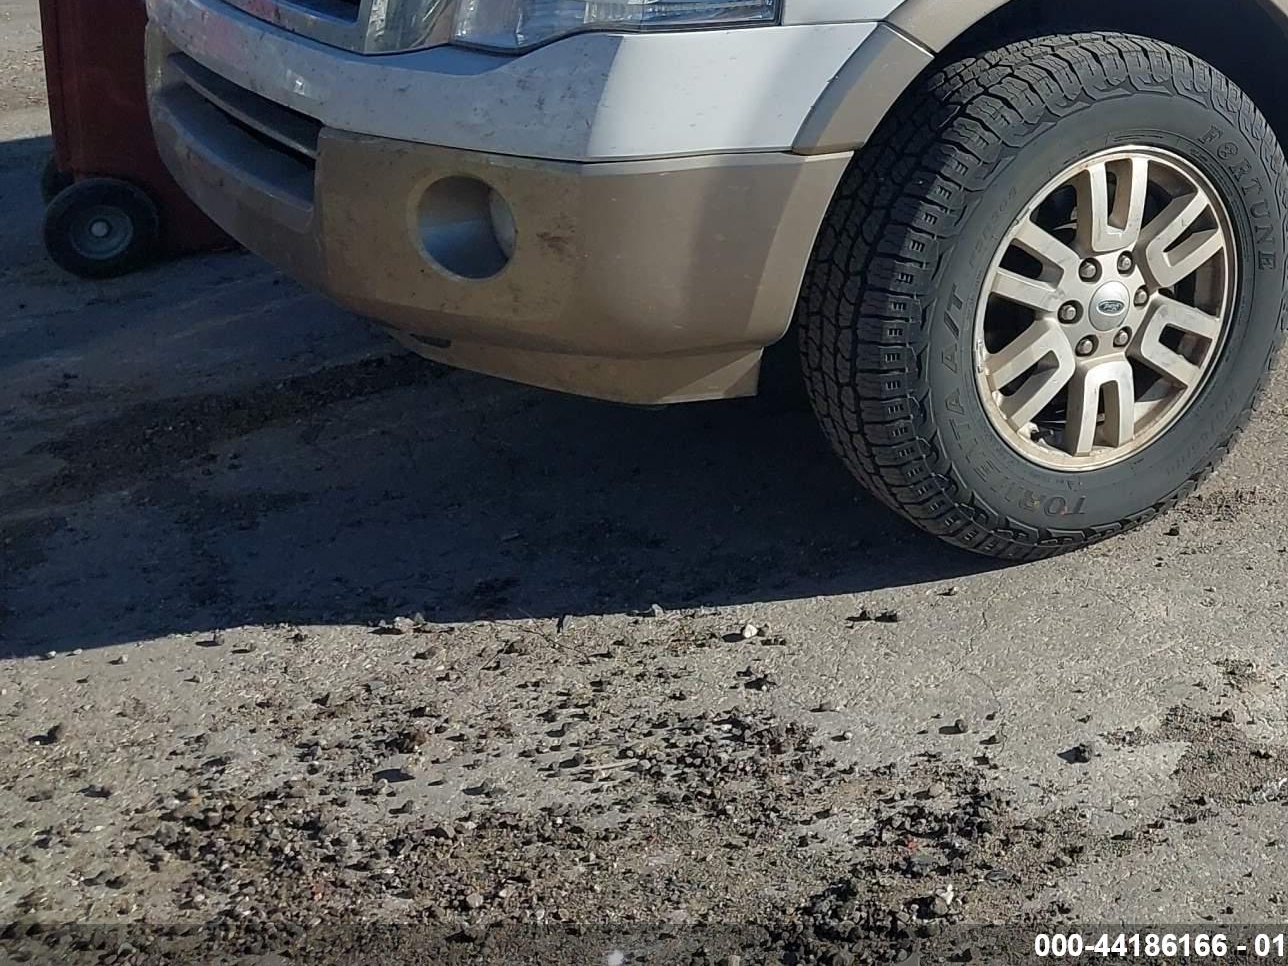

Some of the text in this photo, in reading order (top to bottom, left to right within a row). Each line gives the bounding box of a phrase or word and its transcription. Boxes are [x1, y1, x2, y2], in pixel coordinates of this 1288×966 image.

[1197, 125, 1277, 271] FORTUNE
[941, 283, 1088, 517] TORETA A/T
